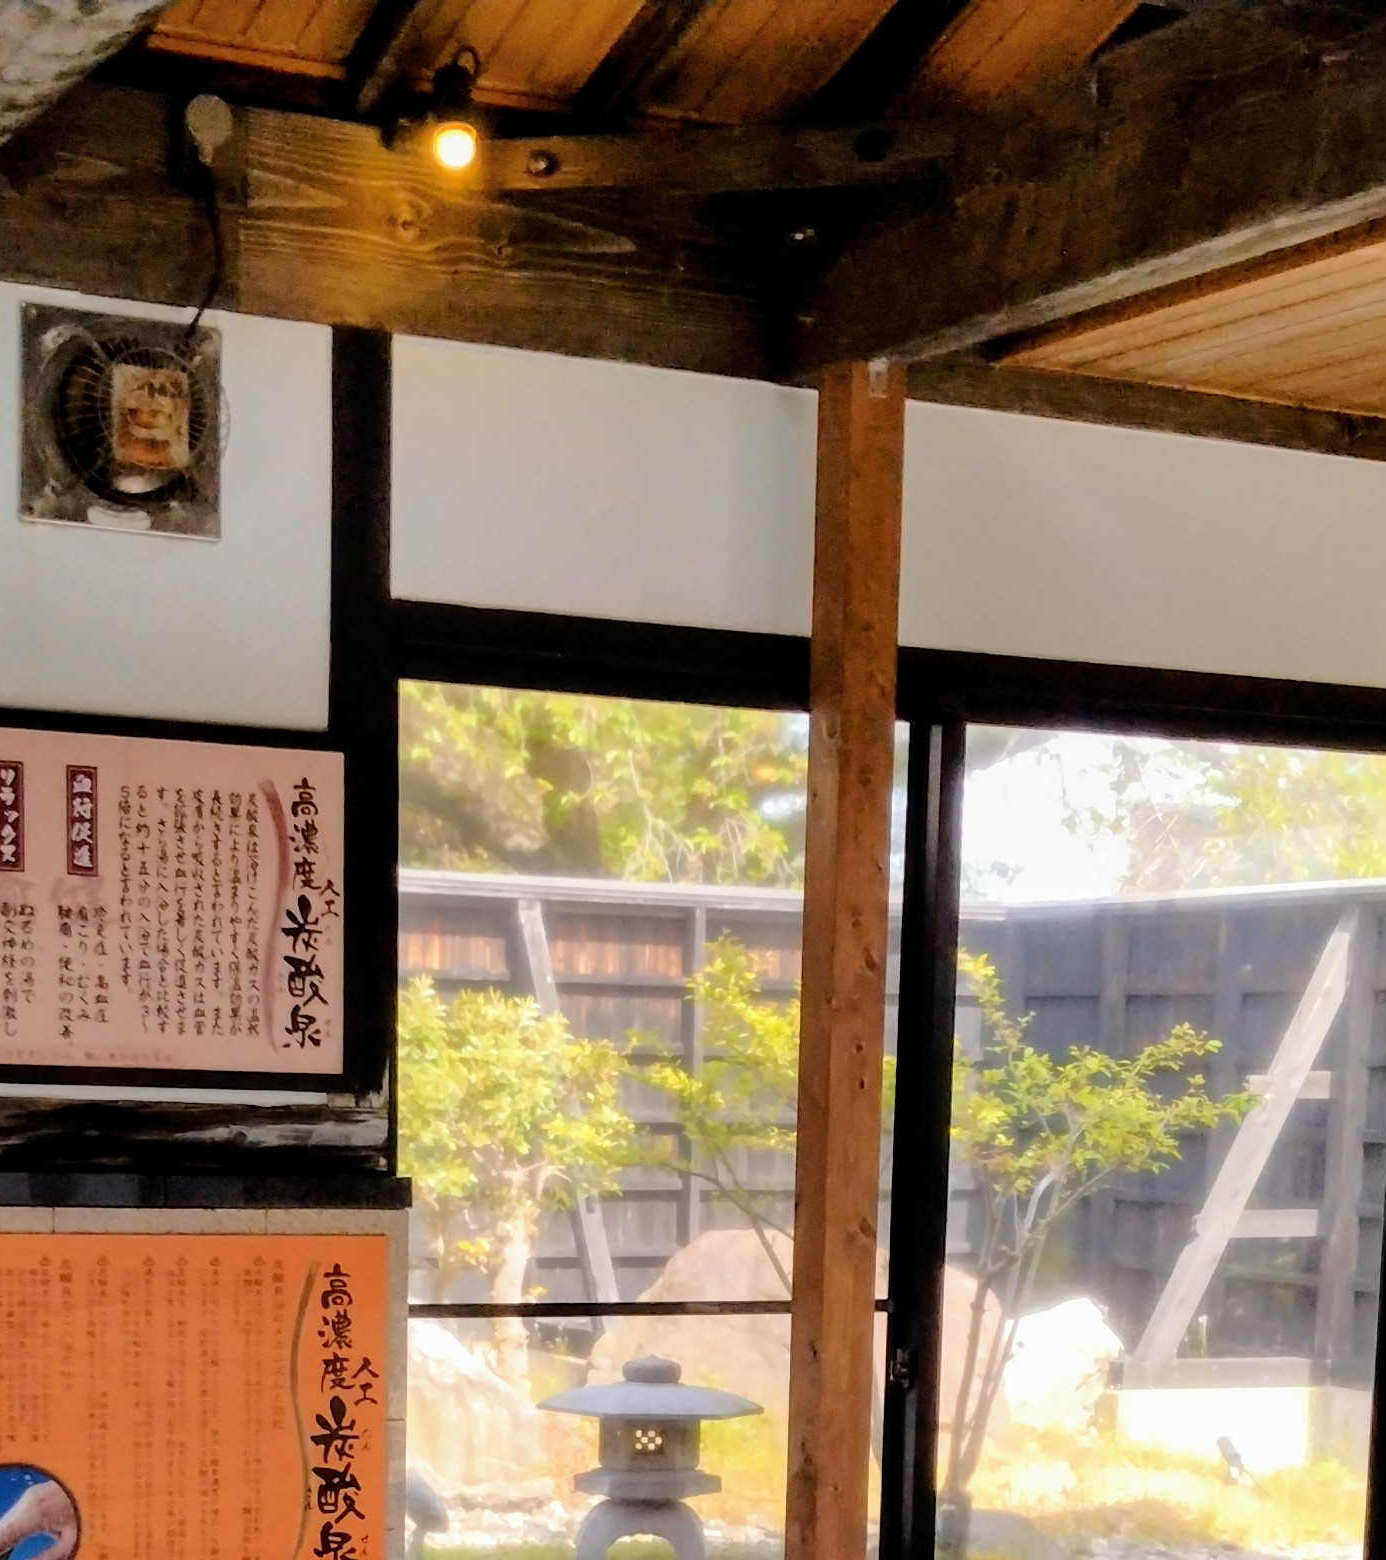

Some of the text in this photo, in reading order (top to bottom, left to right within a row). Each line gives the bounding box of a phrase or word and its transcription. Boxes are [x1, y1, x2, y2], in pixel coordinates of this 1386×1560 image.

[281, 777, 329, 1047] 高濃度炭酸泉
[319, 879, 341, 918] 人工
[352, 1356, 380, 1407] 人工
